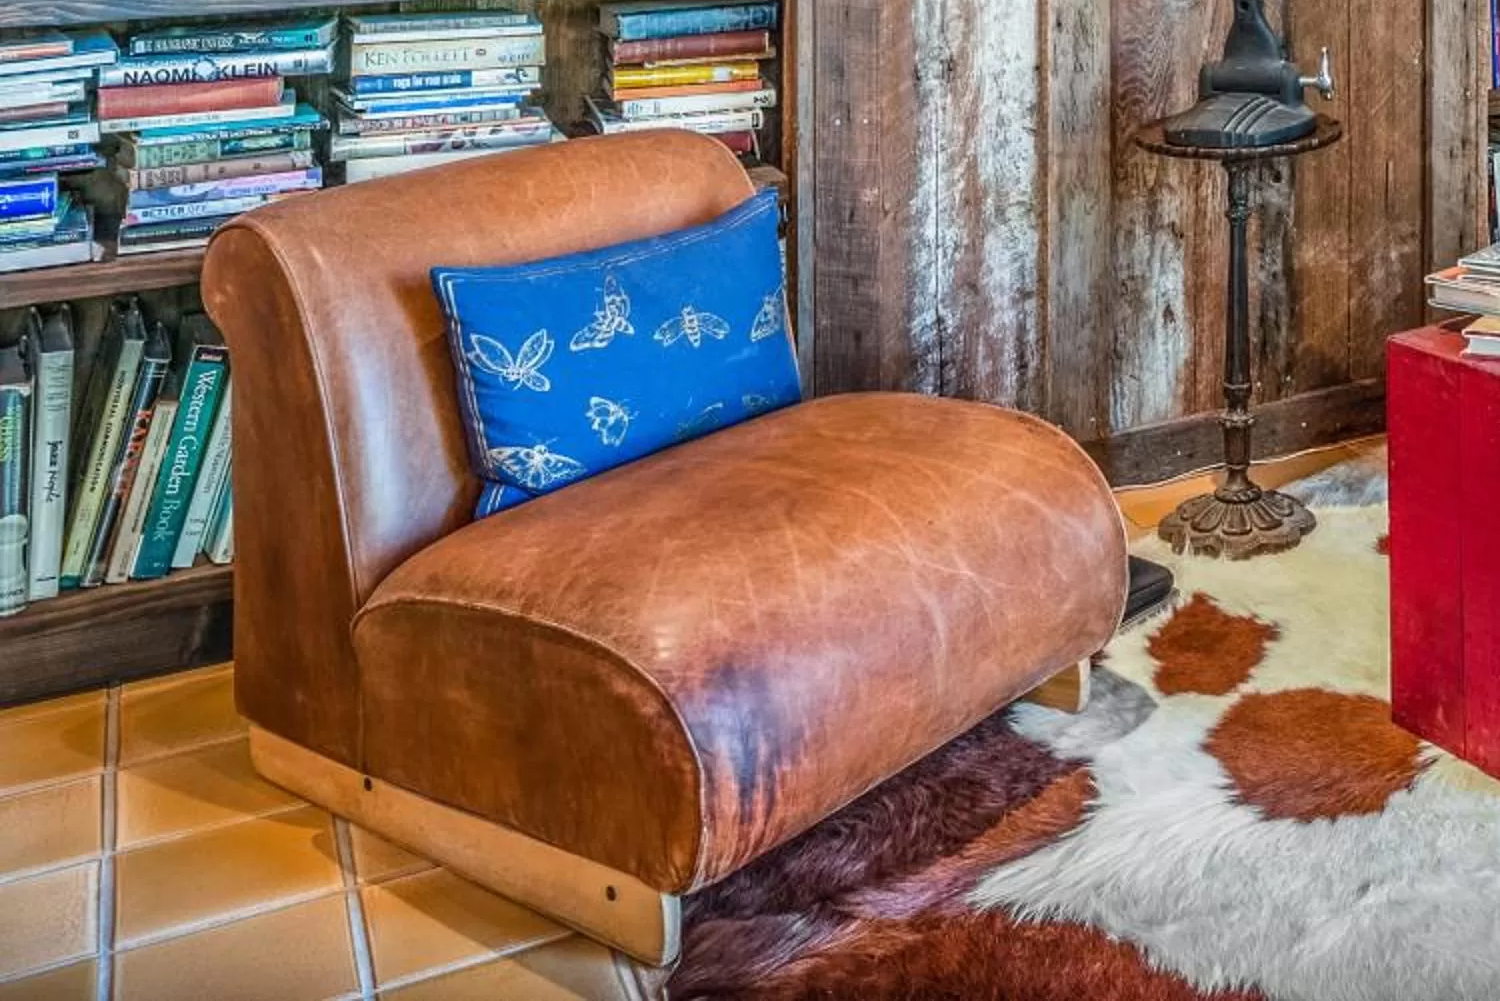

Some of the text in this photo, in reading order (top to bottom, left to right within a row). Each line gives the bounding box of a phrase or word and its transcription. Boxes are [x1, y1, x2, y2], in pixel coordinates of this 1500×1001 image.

[217, 61, 279, 79] KLEIN
[365, 51, 397, 68] KEN
[182, 366, 217, 435] Western
[164, 432, 199, 498] Garden
[151, 496, 181, 544] Book
